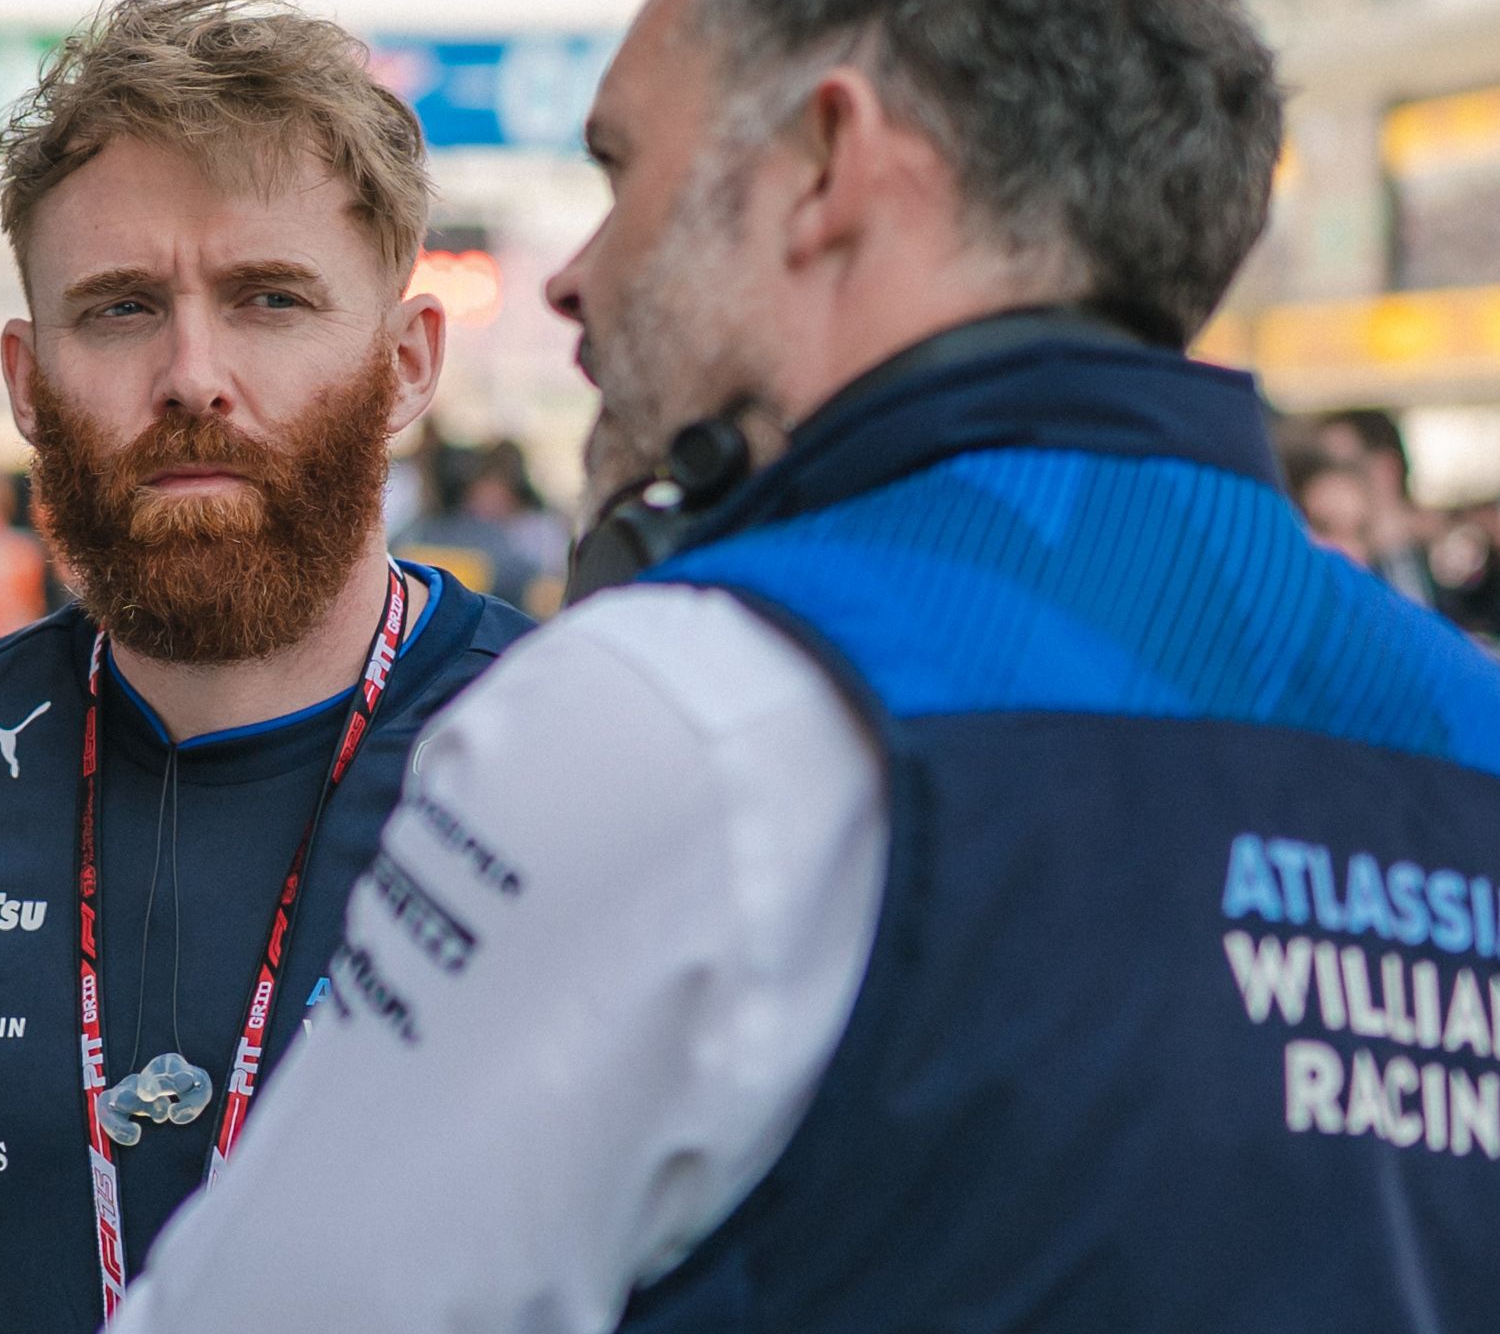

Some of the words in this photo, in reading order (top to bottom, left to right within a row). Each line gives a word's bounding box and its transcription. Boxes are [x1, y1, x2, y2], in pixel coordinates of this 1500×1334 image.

[364, 632, 397, 691] PIT
[82, 973, 98, 1024] GRID
[81, 1033, 106, 1091] PIT
[228, 1036, 263, 1097] PIT
[248, 979, 273, 1029] GRID
